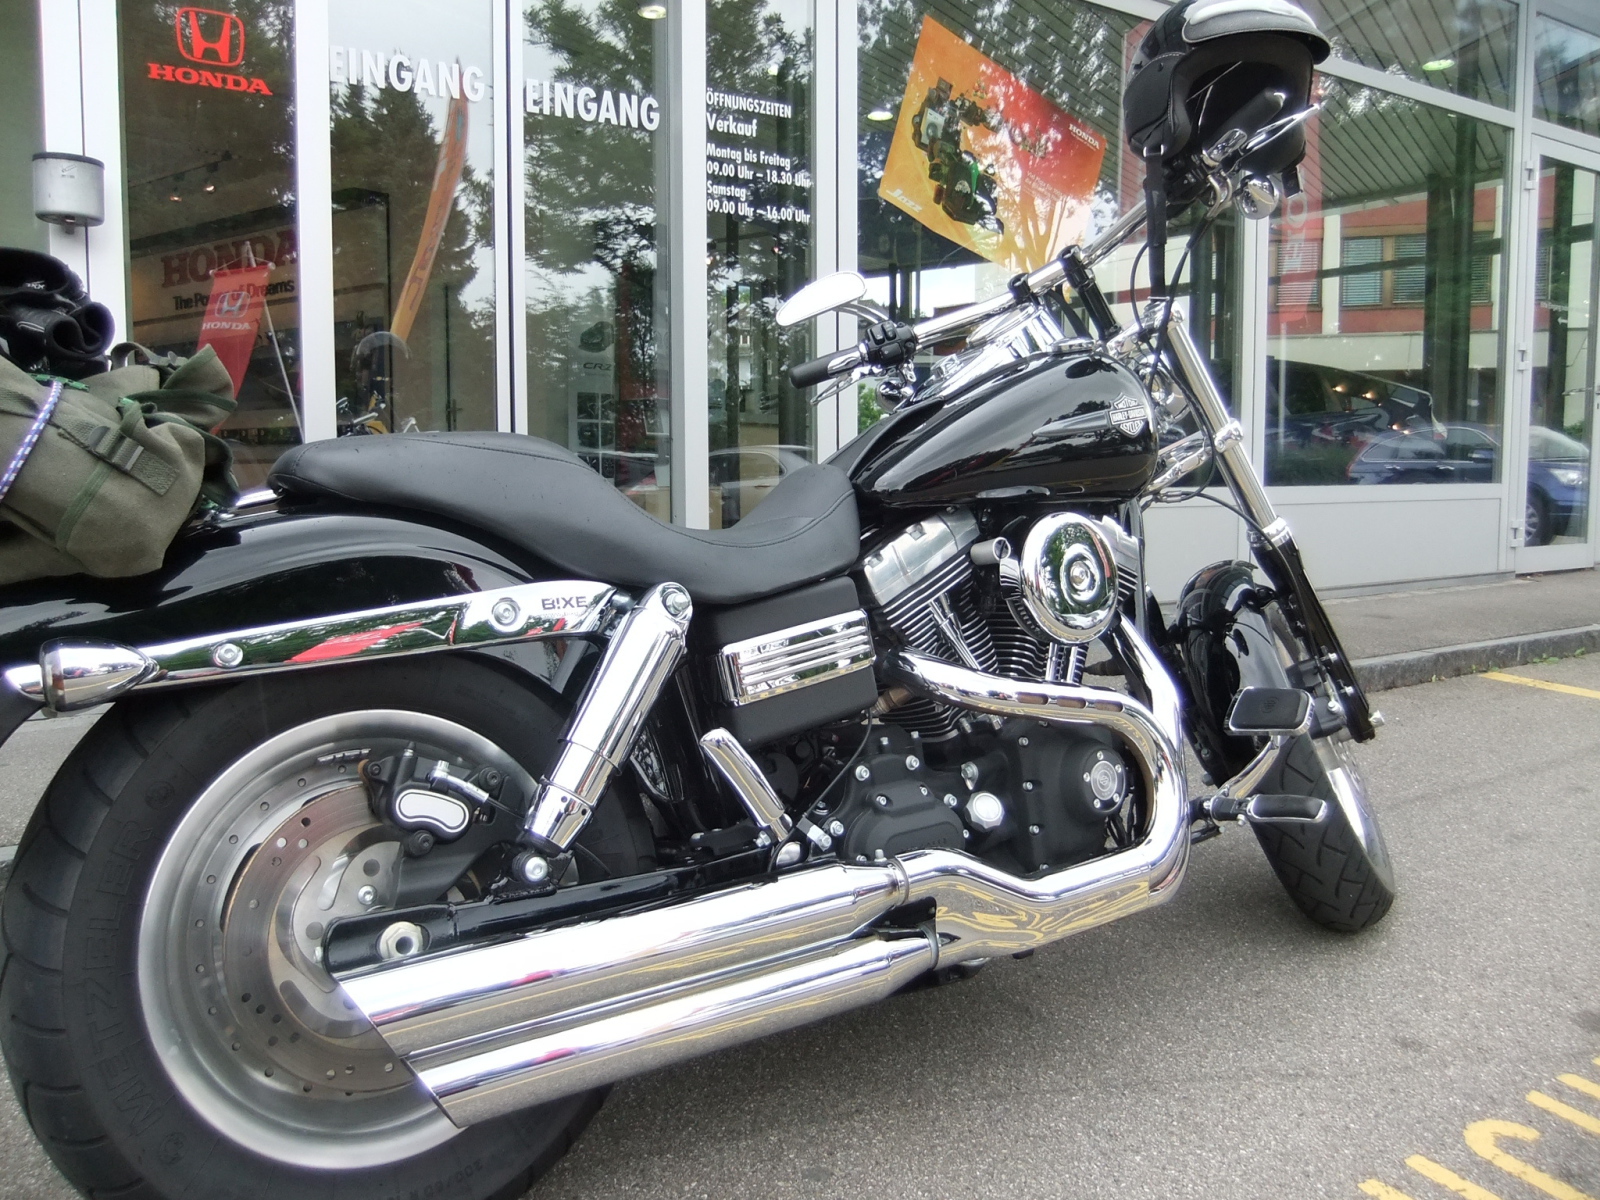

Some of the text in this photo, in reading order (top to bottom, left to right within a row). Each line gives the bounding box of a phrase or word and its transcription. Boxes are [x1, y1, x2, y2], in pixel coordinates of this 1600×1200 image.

[147, 63, 273, 96] HONDA
[329, 45, 485, 102] EINGANG
[525, 78, 660, 131] EINGANG
[706, 87, 792, 118] ÖFFNUNGSZEITEN
[706, 112, 757, 137] Verkauf
[1068, 123, 1099, 150] HONDA
[706, 142, 791, 171] Montag bis Freitag
[706, 160, 735, 177] 09.00
[737, 165, 754, 180] Uhr
[766, 169, 792, 185] 18.30
[794, 173, 811, 188] Uhr
[706, 180, 746, 201] Samstag
[706, 198, 735, 215] 09.00
[737, 202, 754, 217] Uhr
[766, 205, 792, 221] 16.00
[794, 208, 811, 224] Uhr
[161, 229, 298, 289] HONDA
[172, 294, 194, 311] The
[202, 321, 252, 331] HONDA
[82, 819, 162, 1136] METZELER
